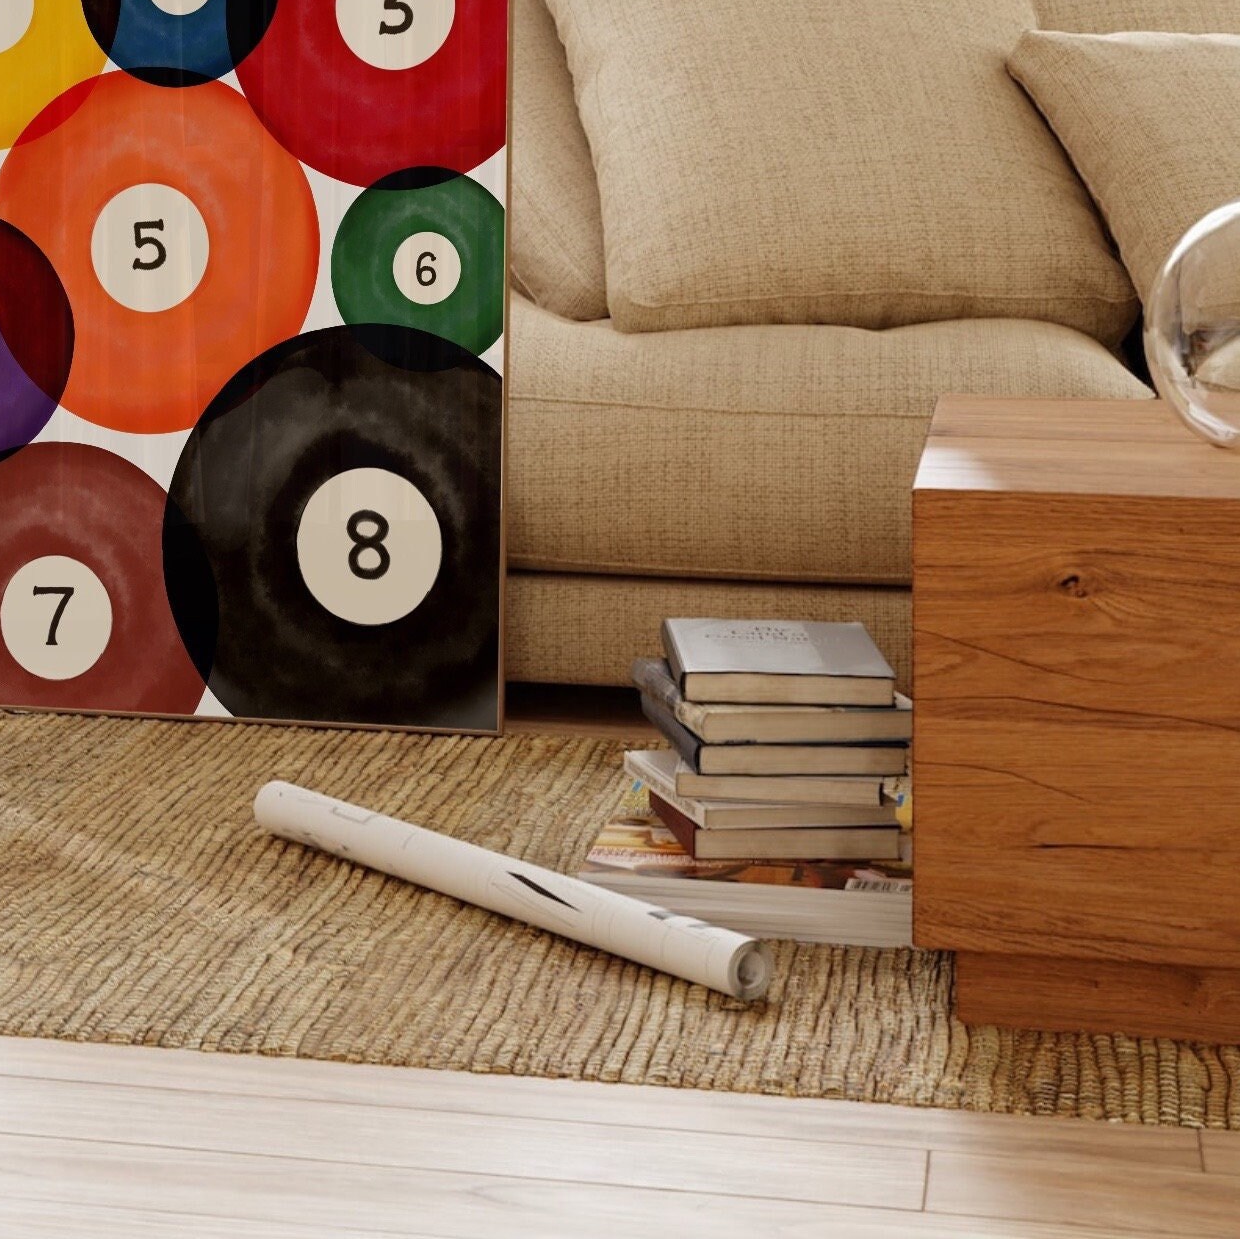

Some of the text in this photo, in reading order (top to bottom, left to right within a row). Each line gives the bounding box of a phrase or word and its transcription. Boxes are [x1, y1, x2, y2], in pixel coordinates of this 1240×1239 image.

[132, 218, 168, 271] 5
[415, 251, 437, 287] 6
[345, 509, 391, 581] 8
[32, 585, 75, 646] 7
